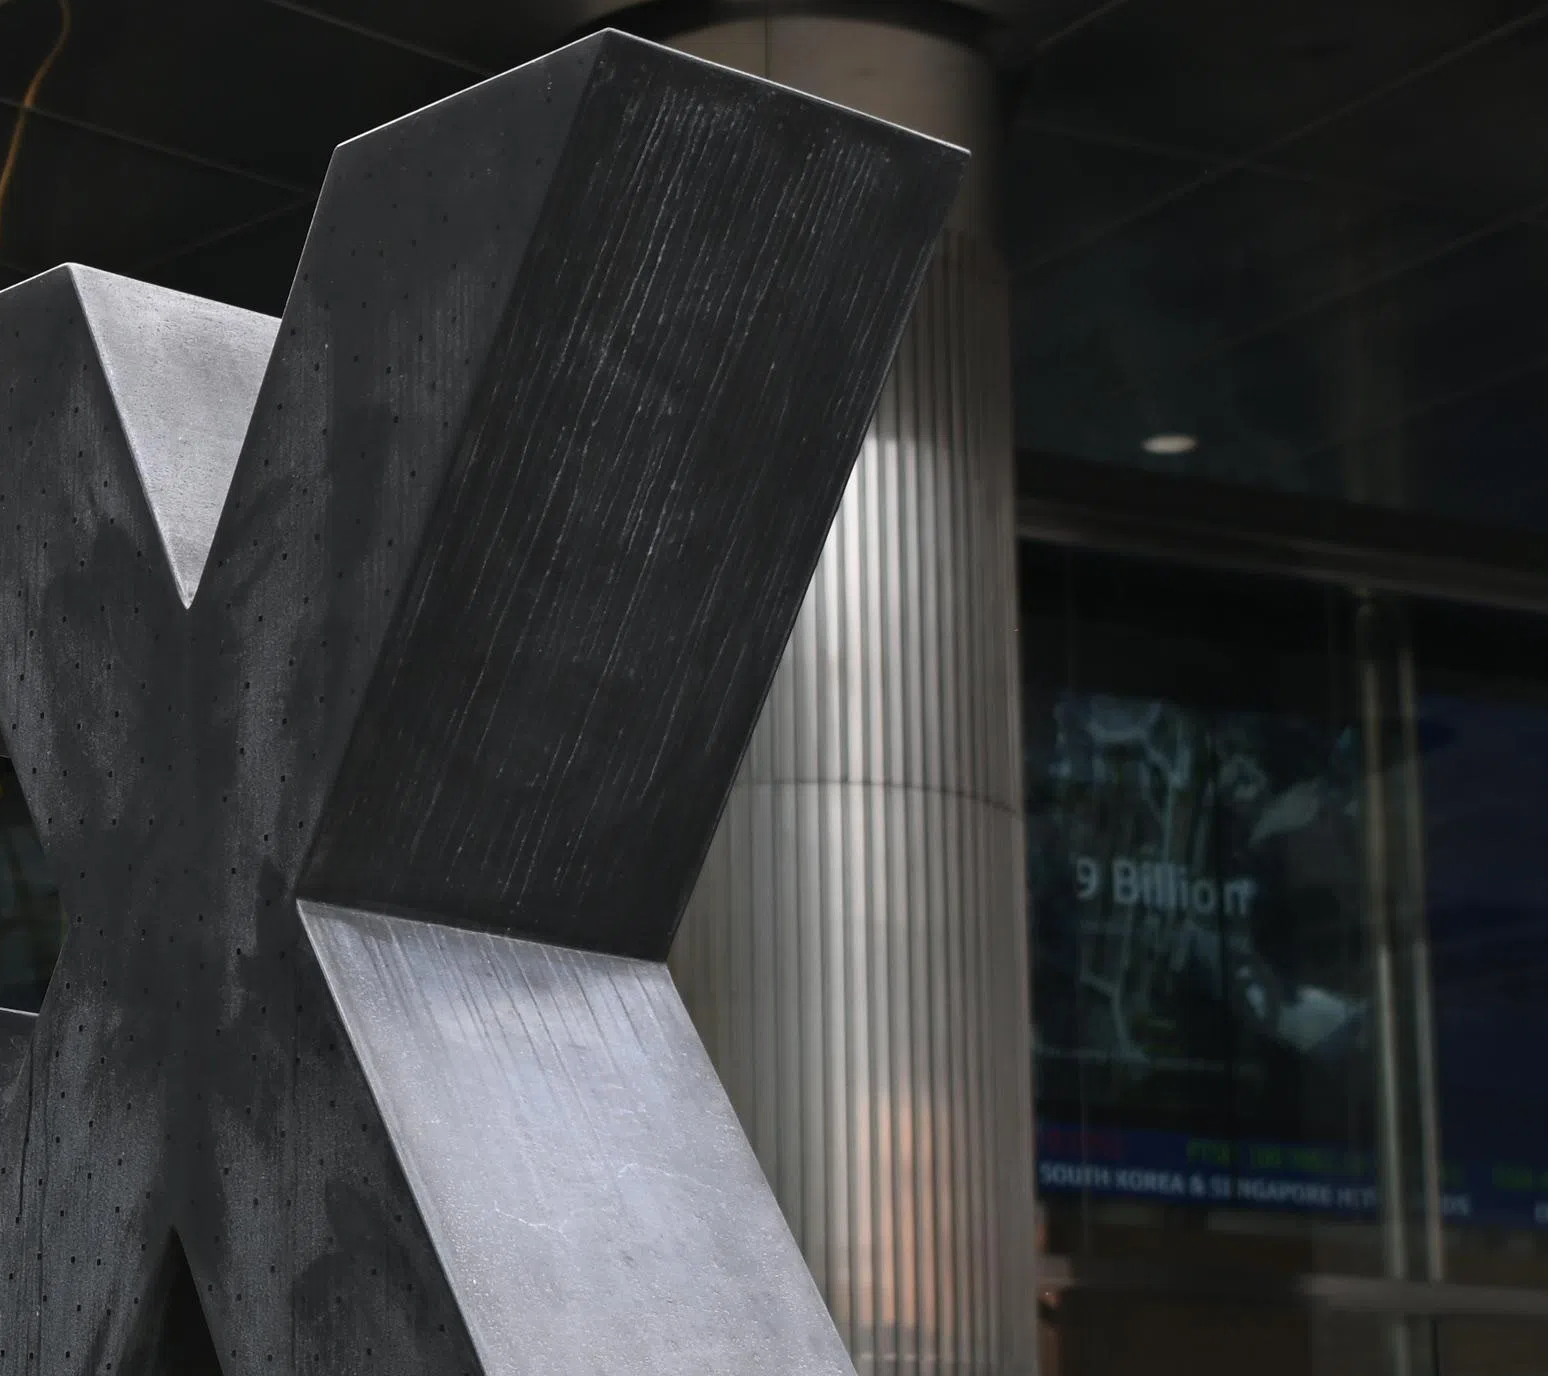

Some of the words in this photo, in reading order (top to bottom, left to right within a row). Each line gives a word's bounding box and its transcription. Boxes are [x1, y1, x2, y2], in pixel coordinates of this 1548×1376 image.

[1111, 855, 1259, 918] Billion
[1039, 1160, 1110, 1186] SOUTH
[1114, 1167, 1186, 1197] KOREA
